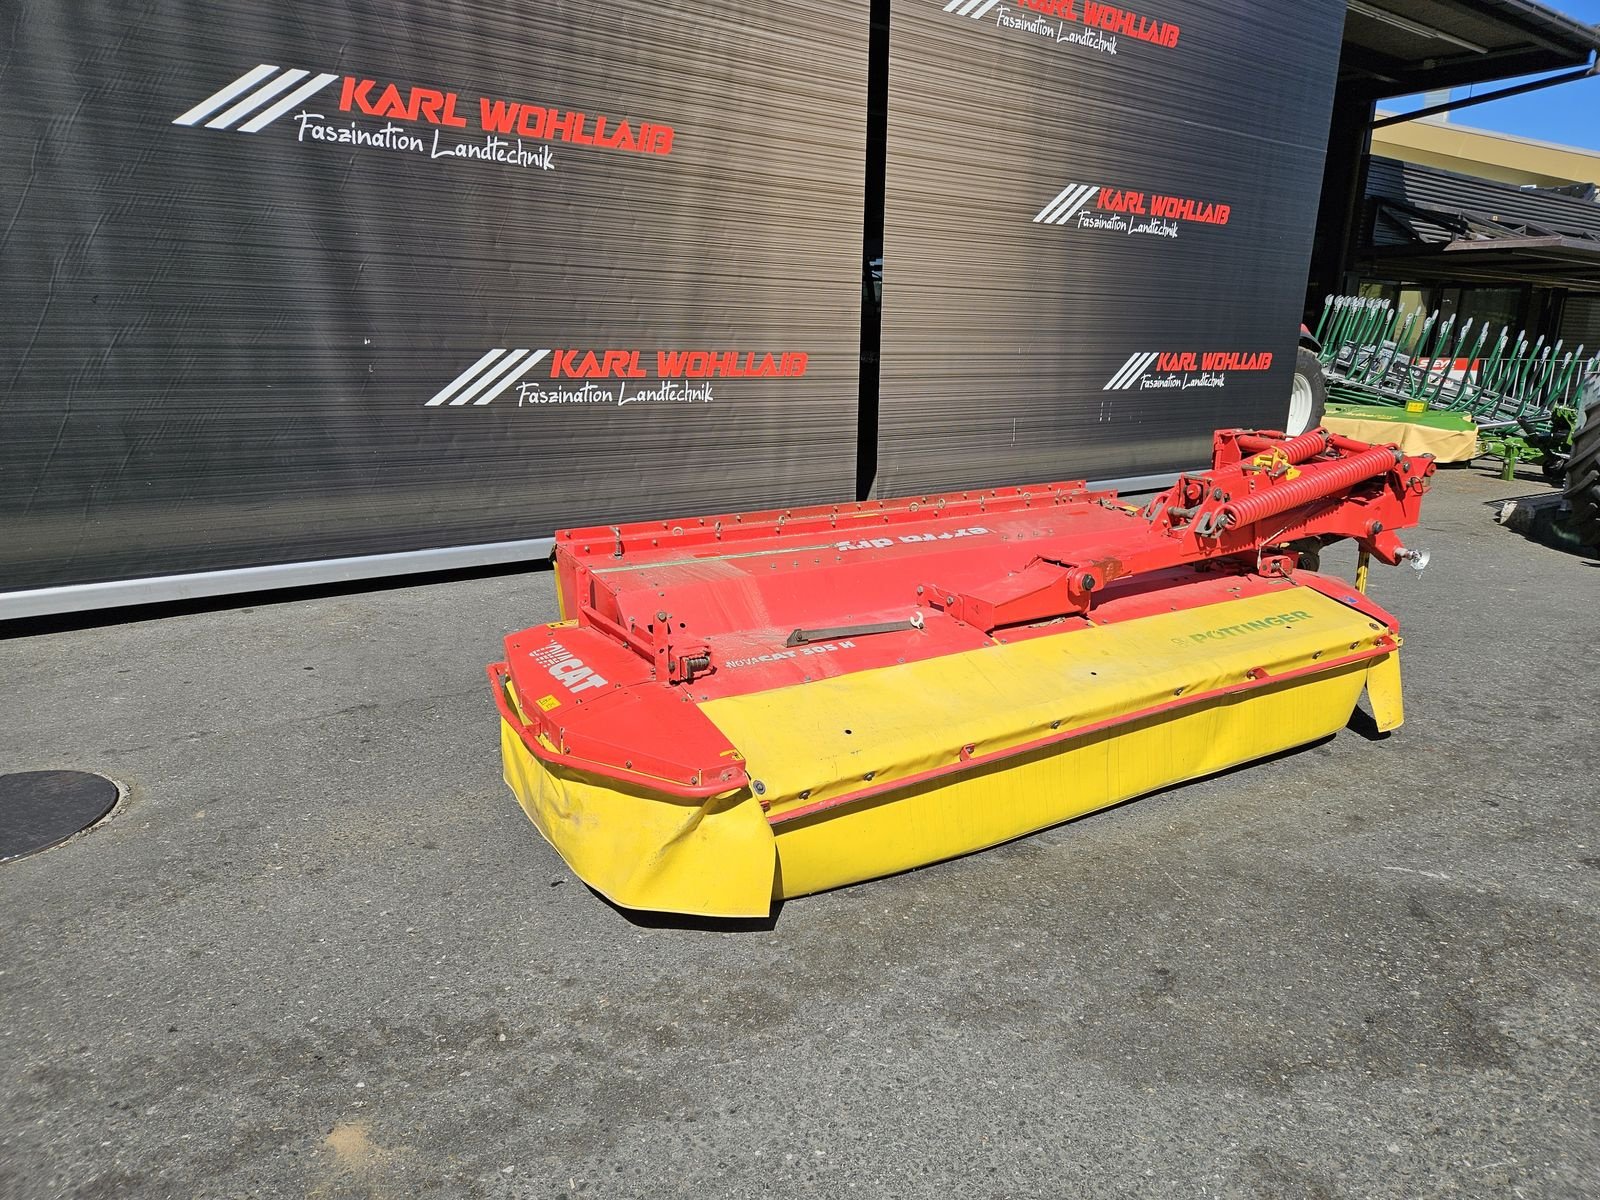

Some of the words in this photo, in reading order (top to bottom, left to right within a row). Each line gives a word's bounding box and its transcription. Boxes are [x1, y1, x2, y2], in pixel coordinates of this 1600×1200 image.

[996, 4, 1055, 38] Faszination
[1056, 21, 1118, 55] Landtechnik
[339, 76, 467, 128] KARL
[480, 97, 675, 155] WOHLLAIB
[294, 110, 424, 153] Faszination
[430, 129, 556, 170] Landtechnik
[1097, 187, 1146, 215] KARL
[1078, 209, 1127, 231] Faszination
[1127, 215, 1178, 238] Landtechnik
[550, 349, 647, 378] KARL
[656, 351, 809, 378] WOHLLAIB
[1156, 352, 1198, 371] KARL
[515, 380, 613, 407] Faszination
[617, 380, 714, 406] Landtechnik
[1139, 373, 1181, 391] Faszination
[1181, 372, 1225, 390] Landtechnik
[835, 537, 894, 551] dry
[800, 643, 838, 655] 305
[838, 640, 856, 649] H
